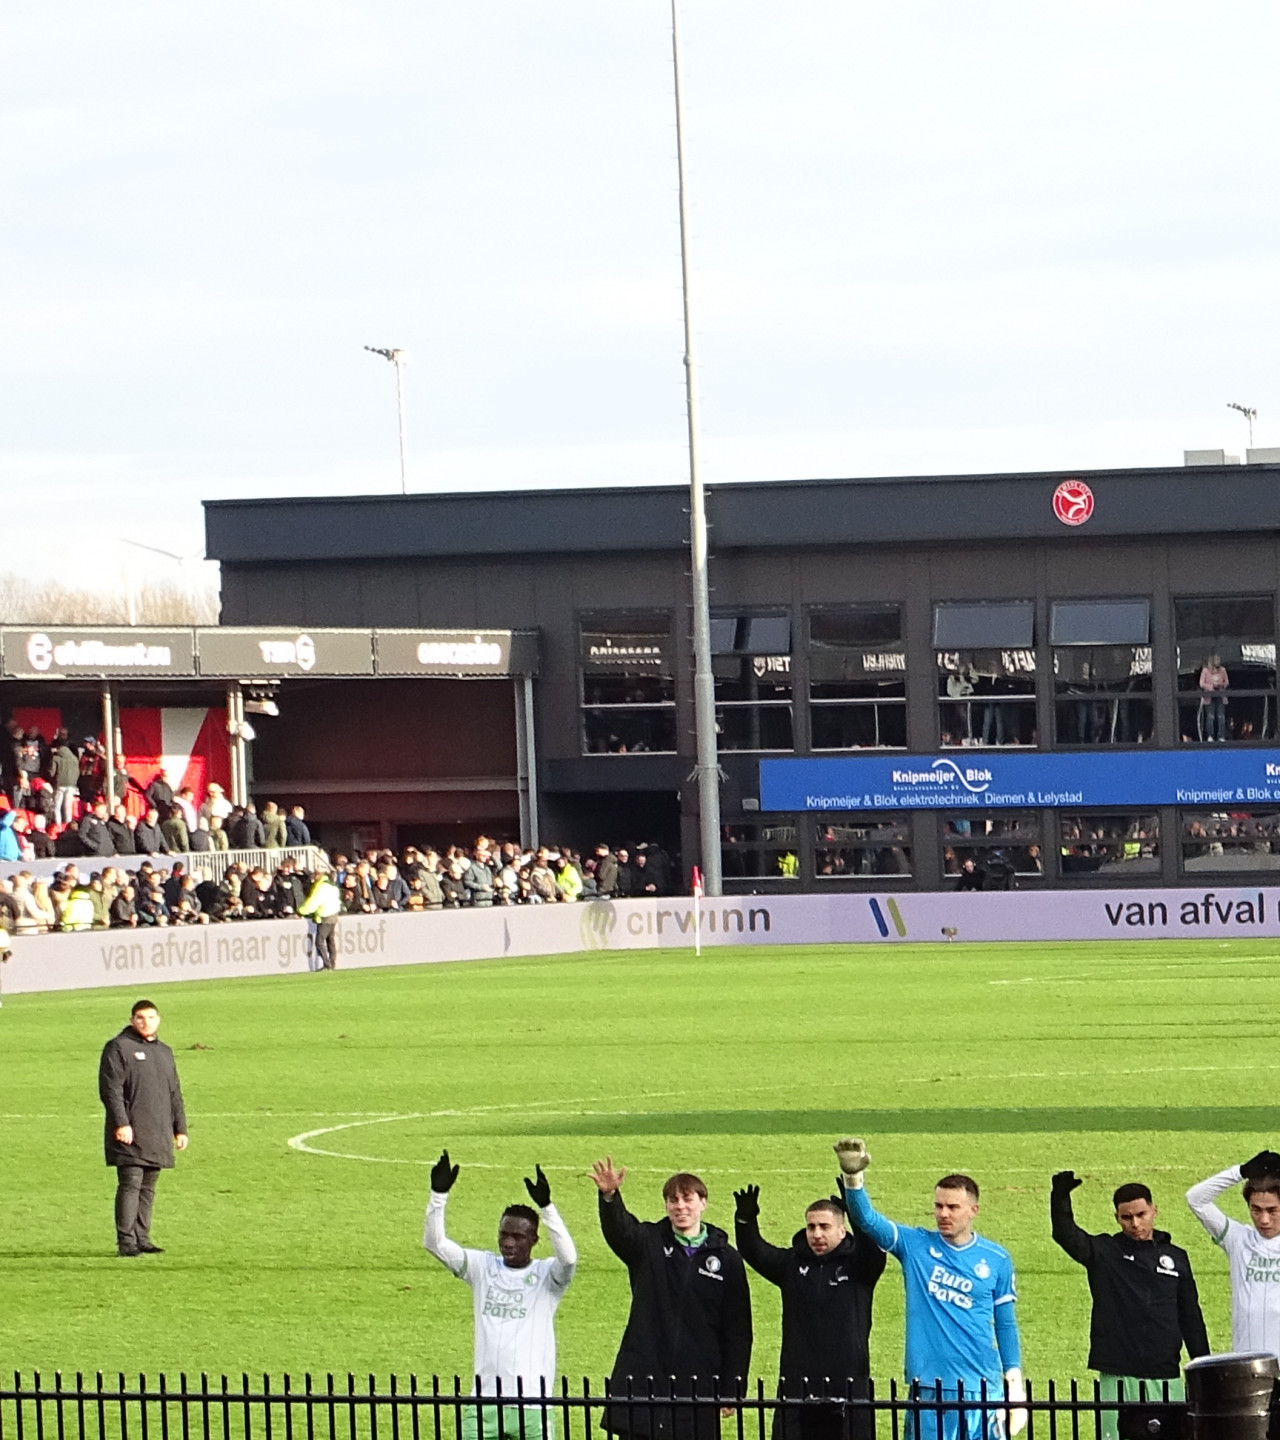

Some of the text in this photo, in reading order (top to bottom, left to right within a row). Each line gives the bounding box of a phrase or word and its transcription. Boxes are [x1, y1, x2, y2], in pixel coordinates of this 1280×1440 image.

[893, 769, 992, 784] Knipmeijer Blok
[807, 791, 1082, 809] Knipmeijer & Blok elektrotechniek Diemen & Lelystad
[1176, 789, 1233, 803] Knipmeijer
[1236, 789, 1244, 800] &
[1247, 787, 1271, 800] Blok
[1105, 901, 1168, 926] van
[1180, 892, 1264, 925] afval
[101, 945, 144, 971] van
[151, 931, 209, 968] afval
[217, 935, 270, 962] naar
[931, 1265, 973, 1292] Euro
[928, 1281, 973, 1309] Parcs
[482, 1301, 527, 1319] Parcs
